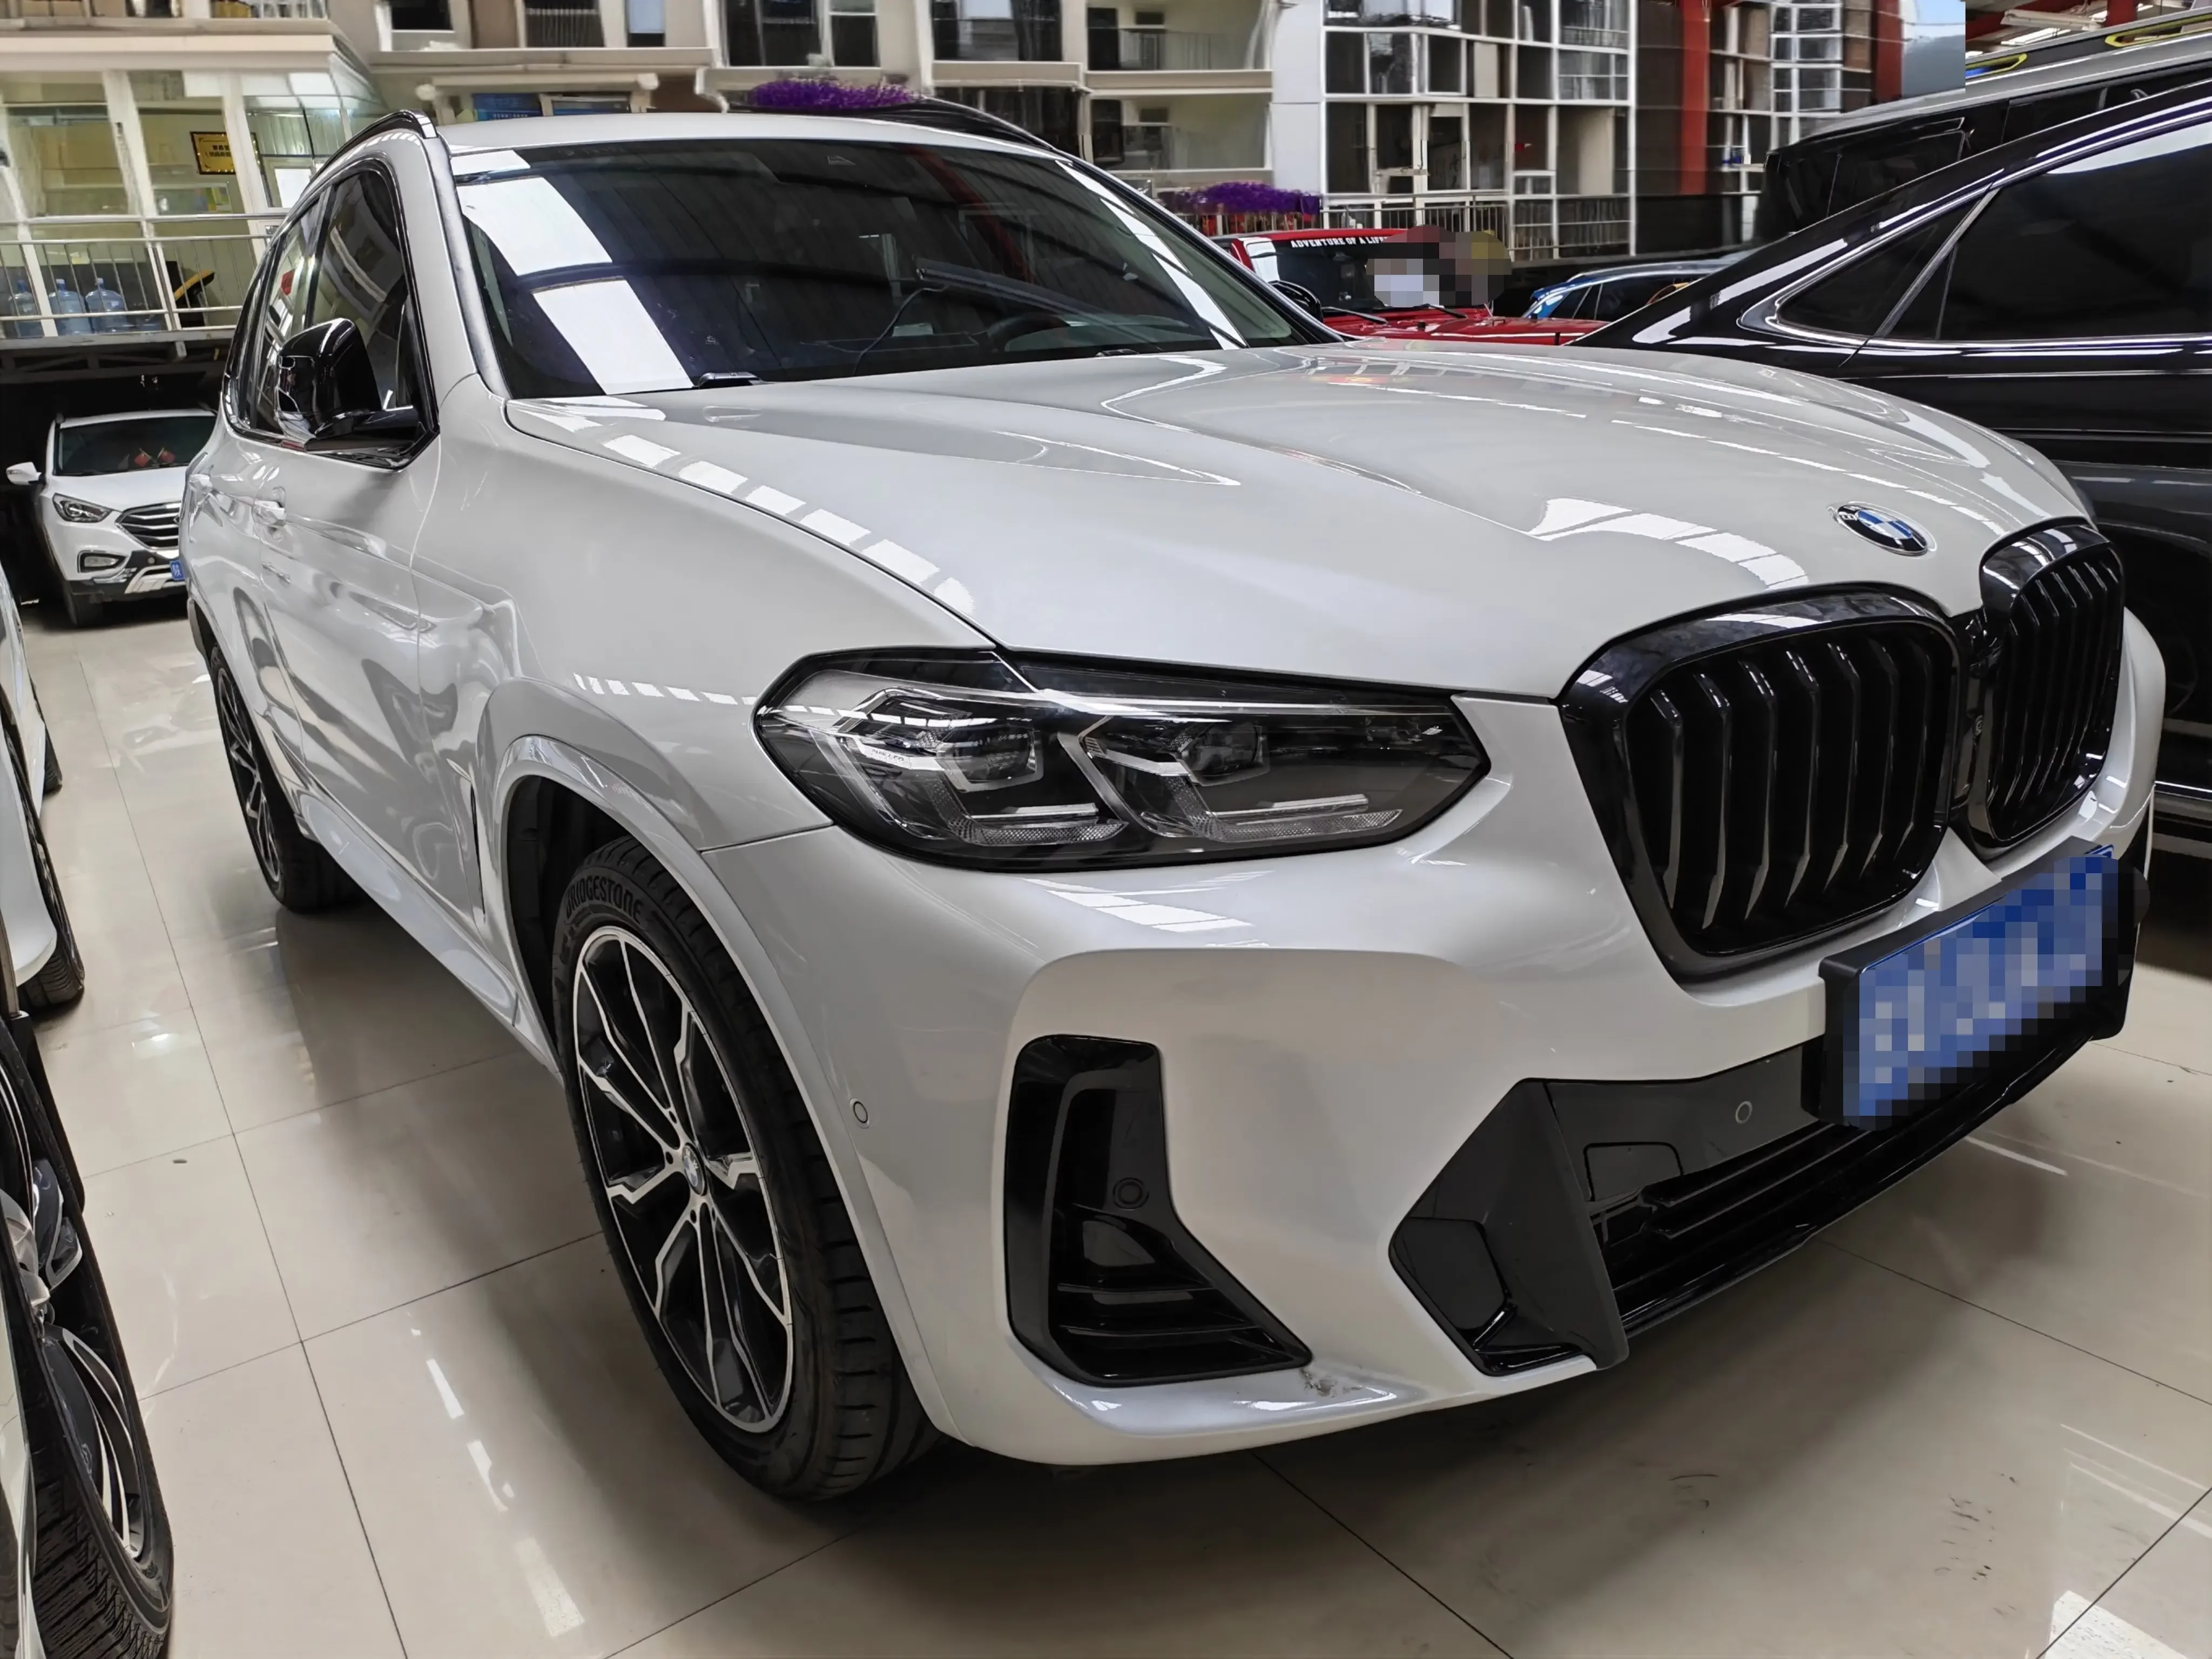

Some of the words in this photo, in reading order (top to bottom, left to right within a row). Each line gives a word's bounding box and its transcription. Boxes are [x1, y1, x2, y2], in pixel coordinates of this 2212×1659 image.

[1290, 237, 1346, 248] ADVENTURE
[1345, 237, 1357, 245] OF
[566, 875, 645, 925] BRIDGESTONE
